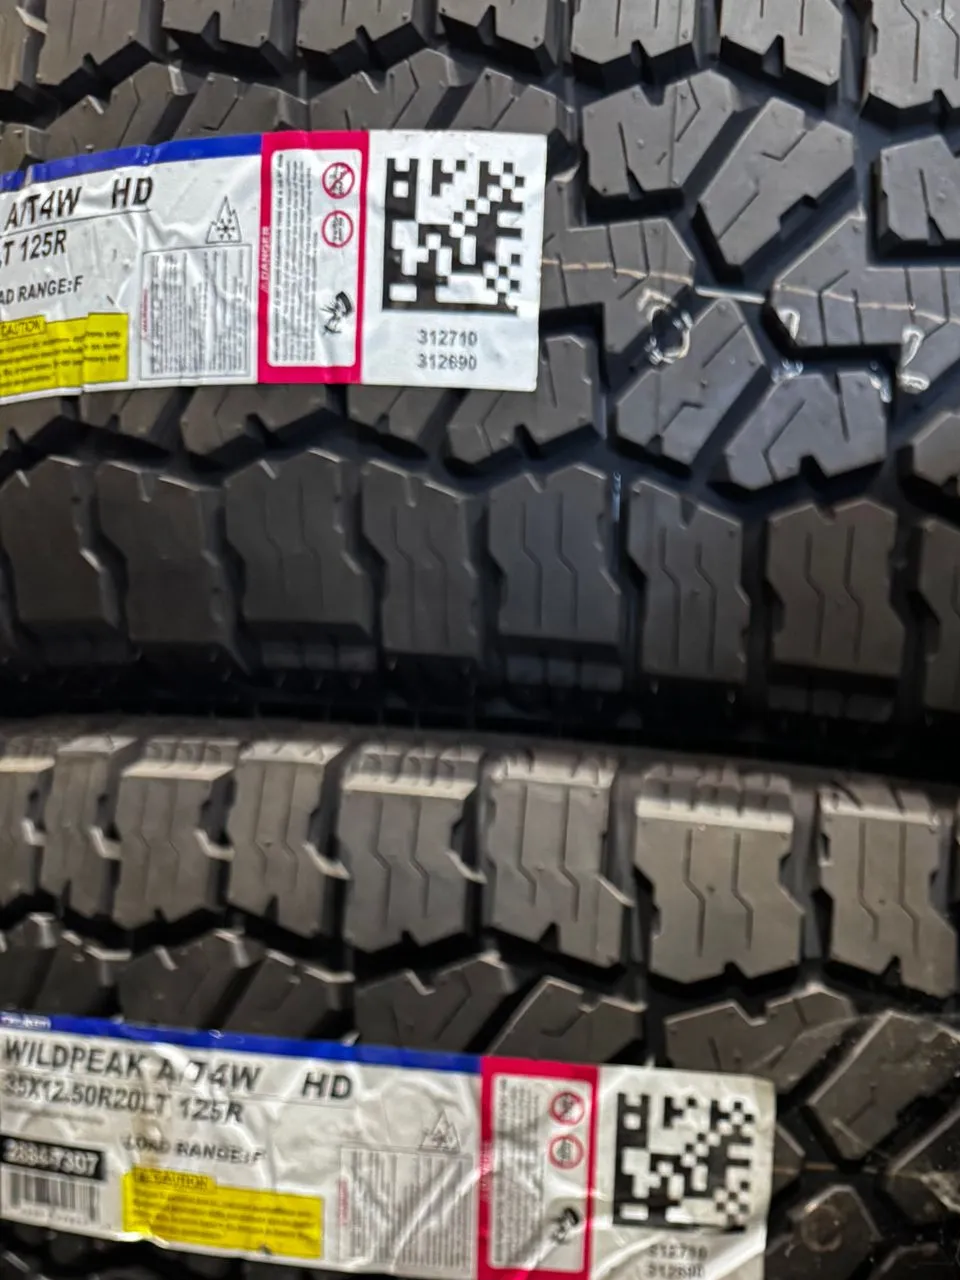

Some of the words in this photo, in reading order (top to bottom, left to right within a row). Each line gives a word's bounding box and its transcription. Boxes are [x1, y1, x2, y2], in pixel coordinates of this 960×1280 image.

[5, 186, 82, 231] A/T4W
[111, 176, 154, 209] HD
[0, 240, 15, 268] T
[20, 229, 68, 262] 125R
[19, 275, 84, 299] RANGE:F
[416, 328, 478, 348] 312710
[416, 352, 477, 371] 312690
[4, 1036, 146, 1079] WILDPEAK
[301, 1072, 353, 1100] HD
[180, 1097, 243, 1123] 125R
